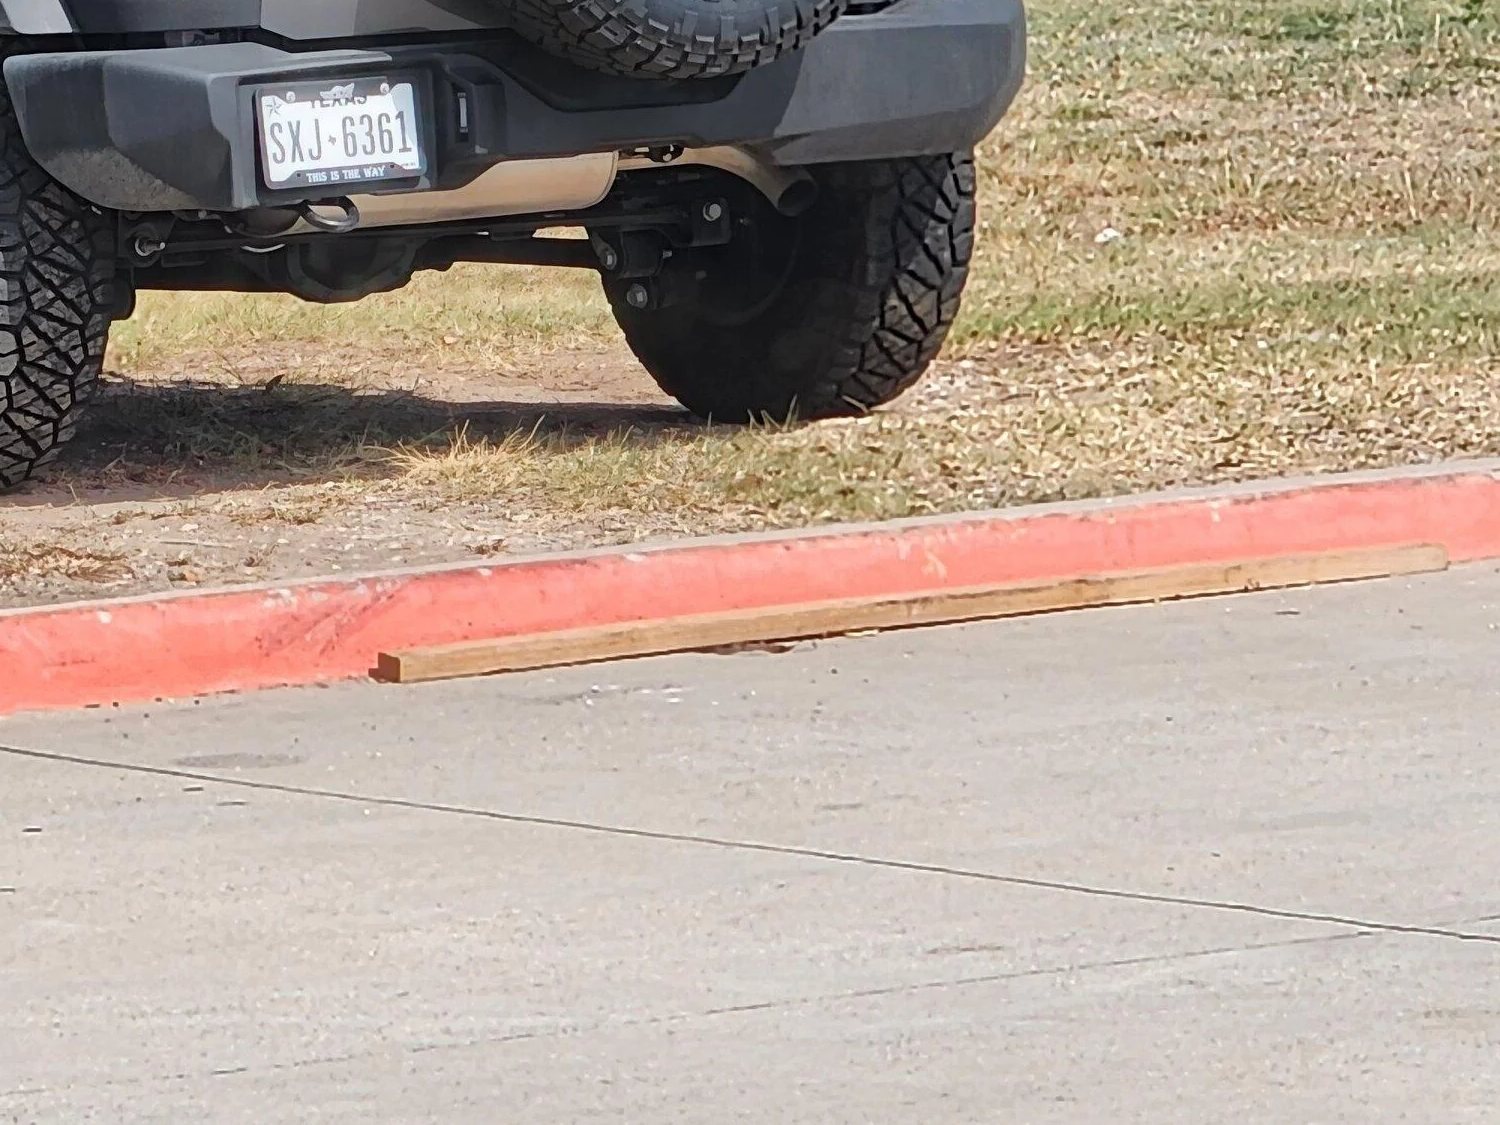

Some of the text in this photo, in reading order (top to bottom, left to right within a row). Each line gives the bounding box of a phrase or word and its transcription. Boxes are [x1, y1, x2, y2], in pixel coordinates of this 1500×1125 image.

[270, 110, 413, 164] SXJ 6361
[306, 165, 386, 183] THIS IS THE WAY
